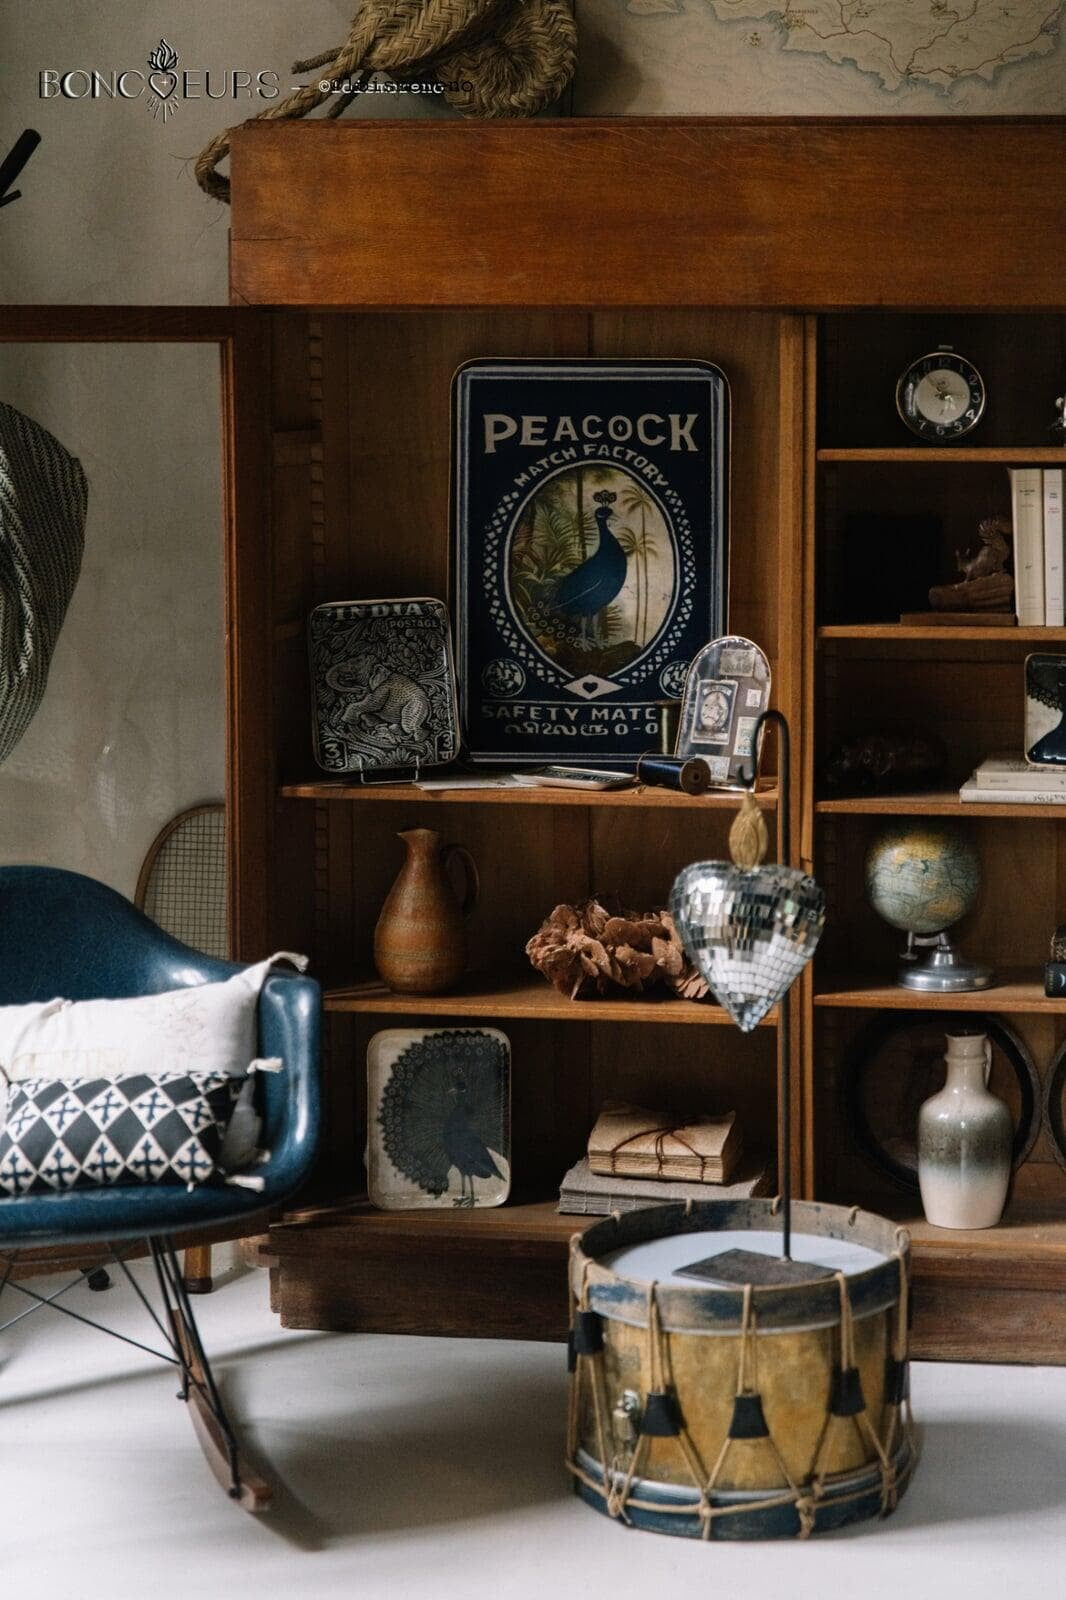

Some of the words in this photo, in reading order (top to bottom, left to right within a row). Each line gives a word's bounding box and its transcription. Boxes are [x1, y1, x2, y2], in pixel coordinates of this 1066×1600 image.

[972, 392, 981, 404] 3
[965, 408, 976, 420] 4
[918, 419, 928, 431] 7
[936, 425, 945, 436] 6
[953, 421, 963, 432] 5
[482, 413, 699, 454] PEACOCK
[513, 446, 578, 488] MATCH
[583, 443, 669, 488] FACTORY
[336, 602, 424, 620] INDIA
[480, 705, 579, 721] SAFETY
[324, 742, 342, 759] 3
